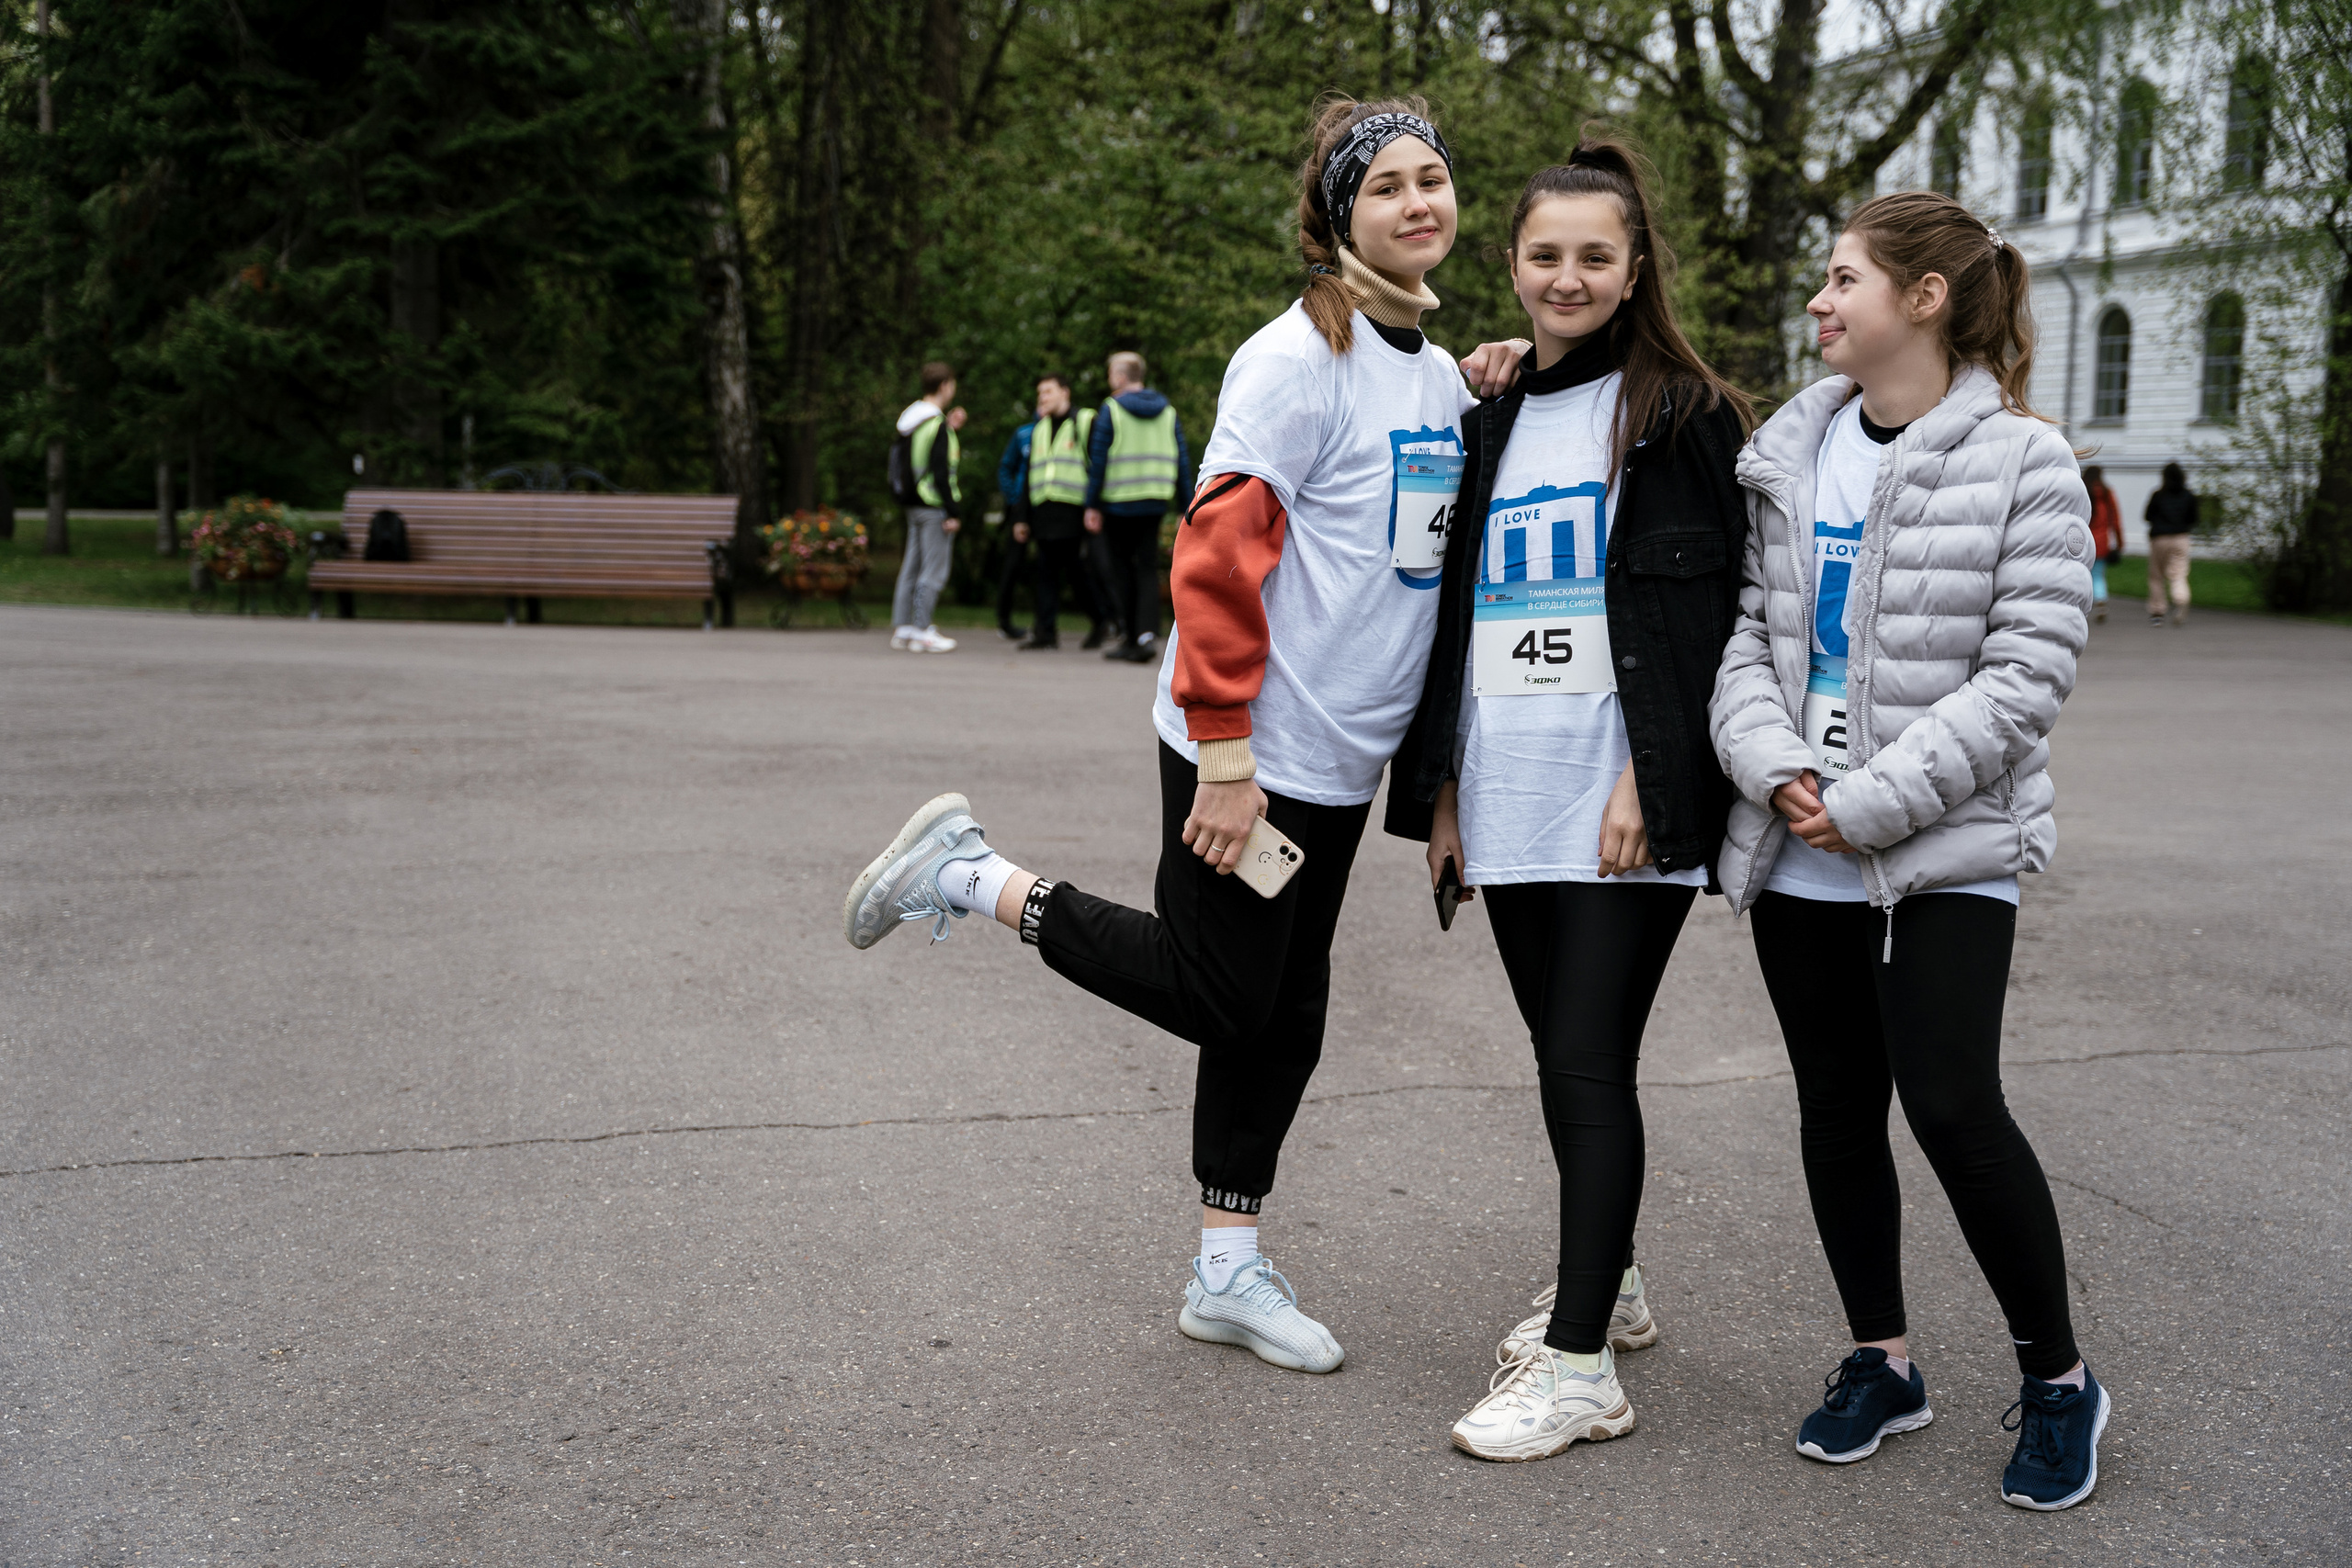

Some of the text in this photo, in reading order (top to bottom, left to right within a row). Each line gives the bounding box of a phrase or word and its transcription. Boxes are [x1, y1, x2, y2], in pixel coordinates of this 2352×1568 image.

[1495, 508, 1541, 527] I LOVE
[1528, 586, 1605, 598] ТАМАНСКАЯ МИЛЯ
[1527, 599, 1604, 611] В СЕРДЦЕ СИБИРИ
[1511, 627, 1573, 666] 45
[1529, 676, 1561, 684] ЭФКО
[1021, 902, 1046, 944] OVE
